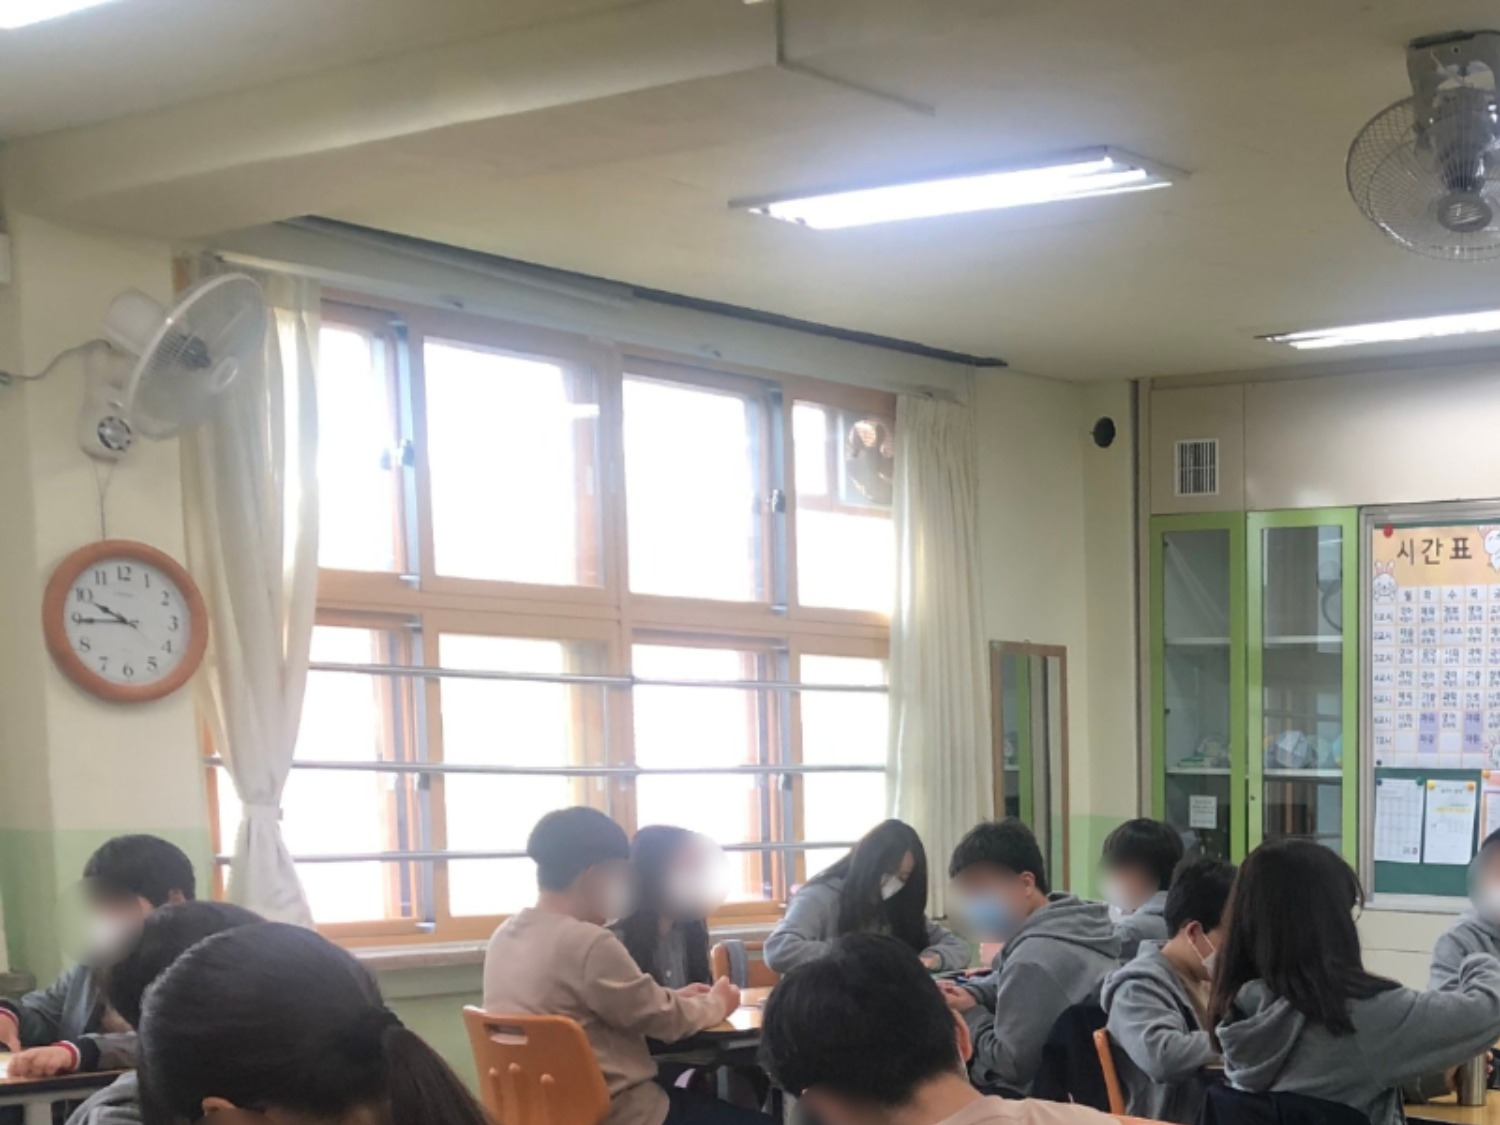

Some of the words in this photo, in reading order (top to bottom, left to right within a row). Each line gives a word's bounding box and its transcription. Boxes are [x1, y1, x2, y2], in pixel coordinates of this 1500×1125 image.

[1396, 537, 1473, 566] 시간표
[94, 570, 107, 585] 11
[117, 566, 132, 582] 12
[143, 573, 151, 588] 1
[76, 586, 93, 603] 10
[161, 590, 170, 606] 2
[1446, 589, 1458, 600] 수
[168, 615, 179, 631] 3
[79, 637, 91, 652] 8
[161, 639, 172, 654] 4
[98, 656, 109, 672] 7
[122, 663, 134, 678] 6
[146, 656, 158, 672] 5
